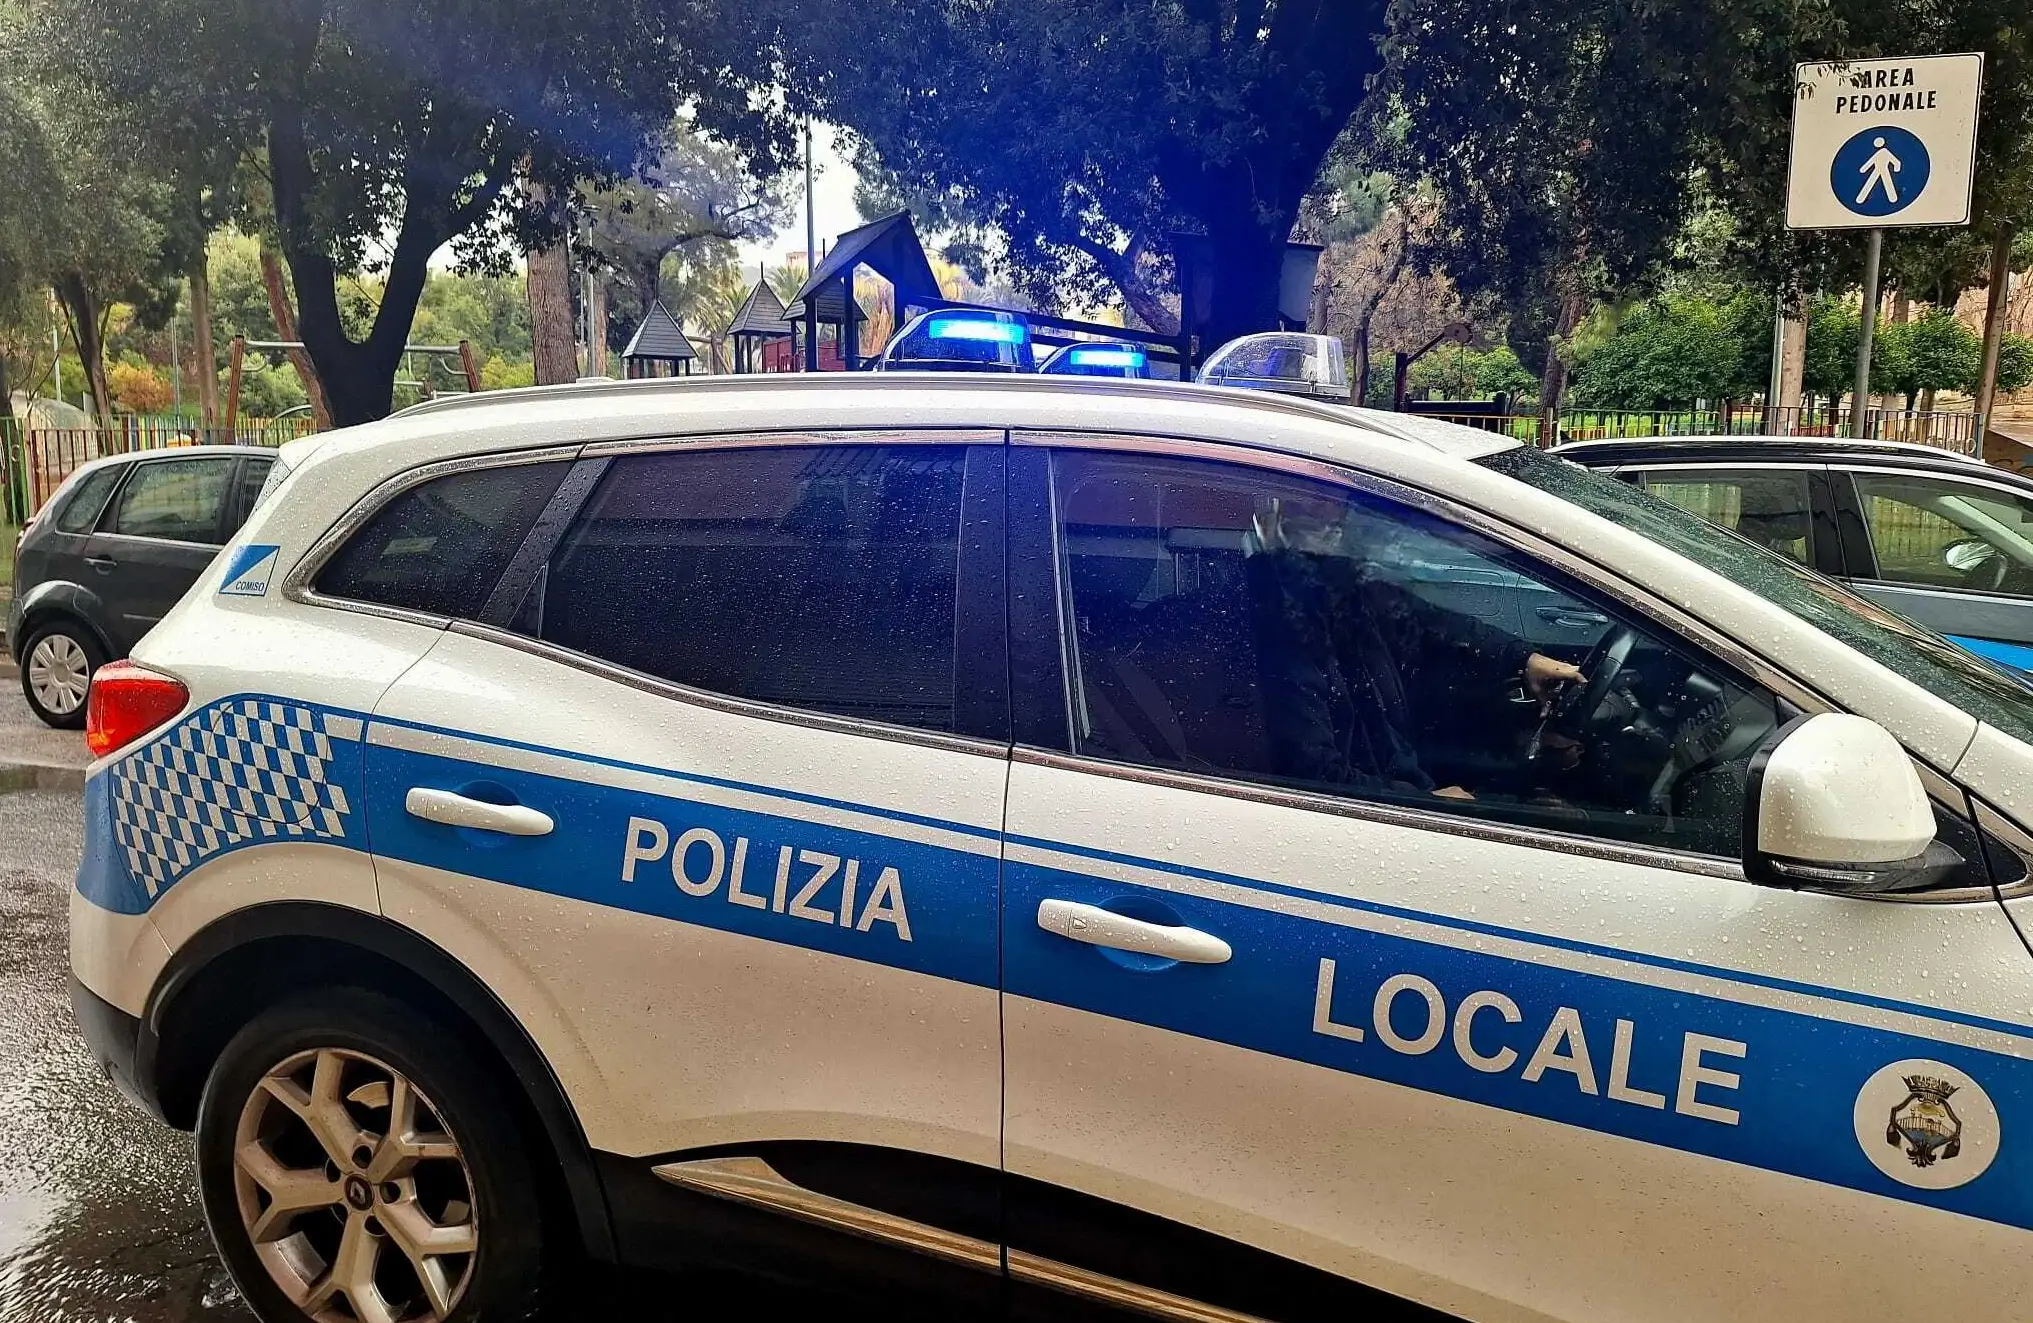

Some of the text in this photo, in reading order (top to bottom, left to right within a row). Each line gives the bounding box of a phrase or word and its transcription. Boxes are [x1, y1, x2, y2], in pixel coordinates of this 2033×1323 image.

[1860, 67, 1914, 89] AREA
[1836, 90, 1937, 114] PEDONALE
[235, 581, 265, 592] COMISO
[622, 816, 913, 942] POLIZIA
[1312, 957, 1748, 1126] LOCALE
